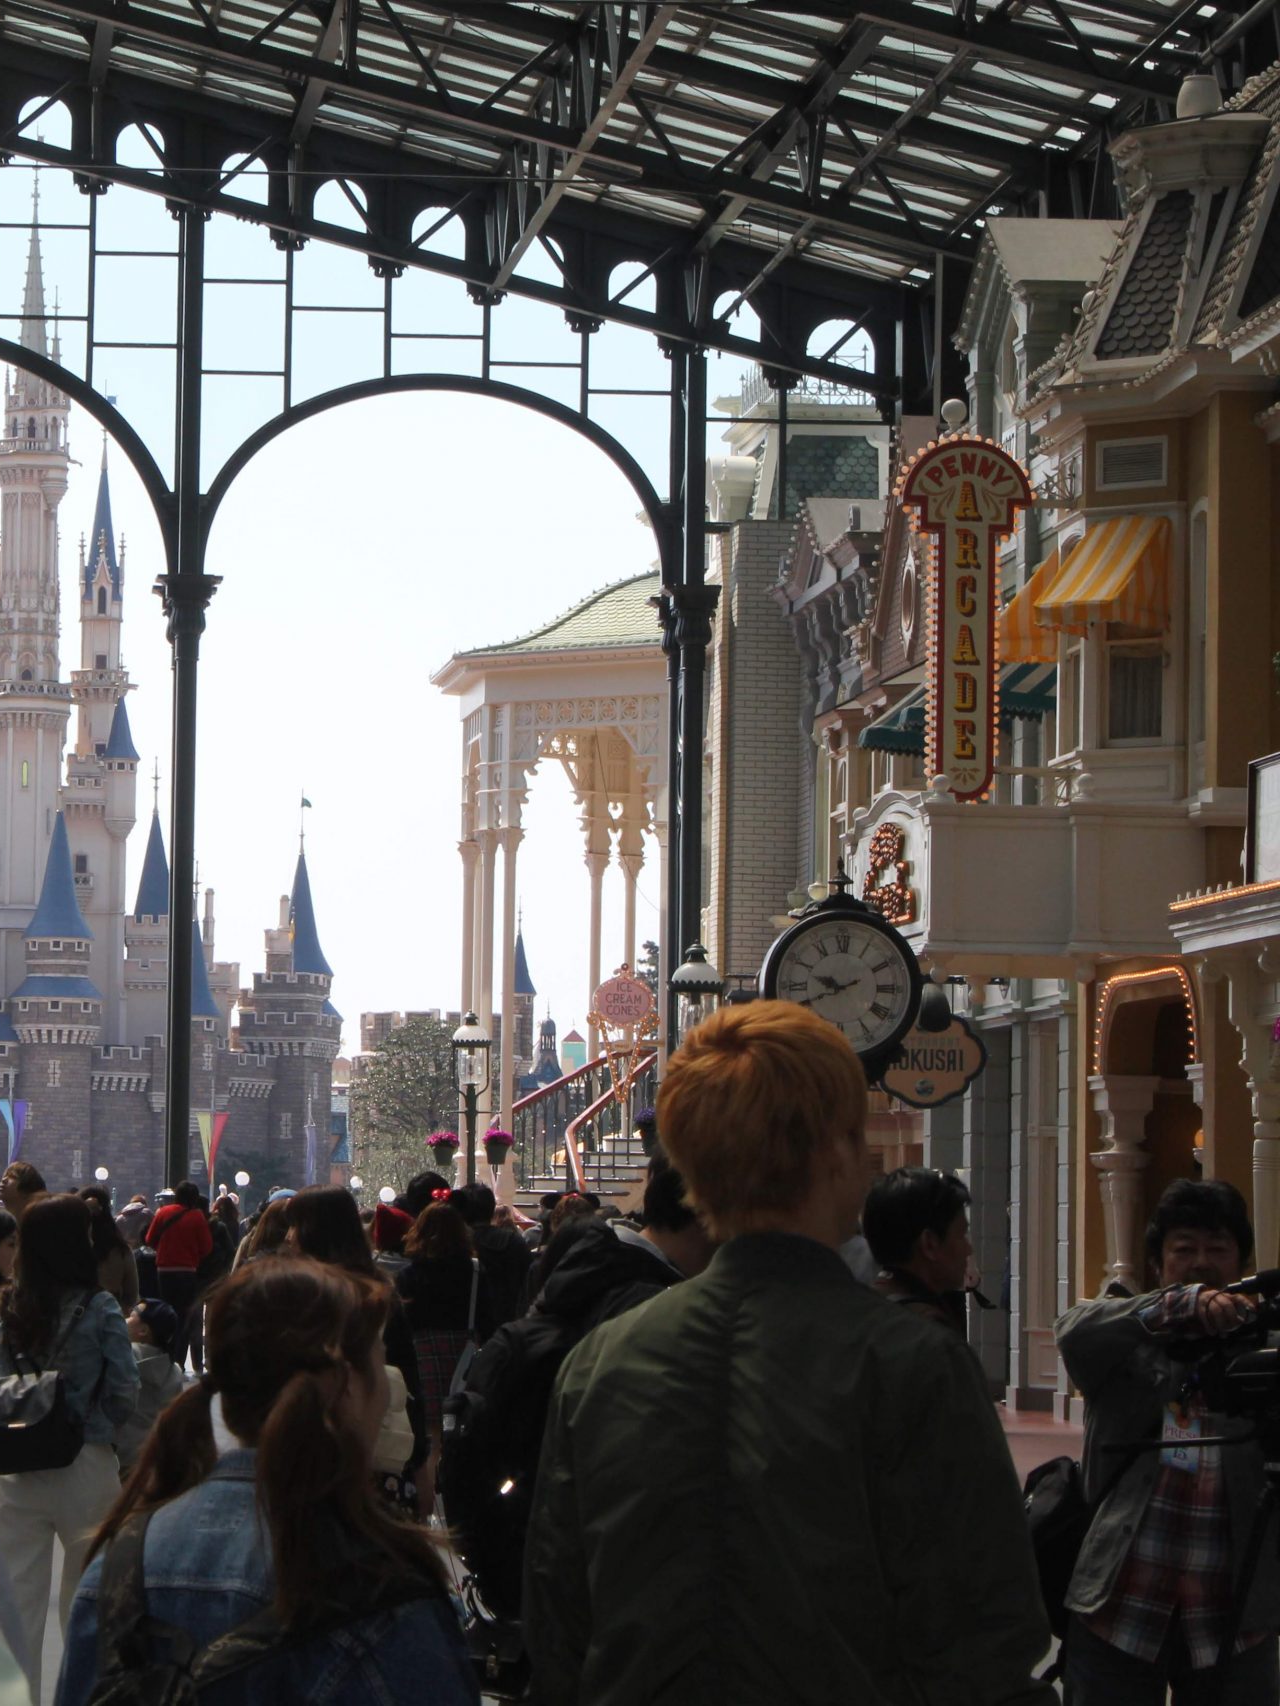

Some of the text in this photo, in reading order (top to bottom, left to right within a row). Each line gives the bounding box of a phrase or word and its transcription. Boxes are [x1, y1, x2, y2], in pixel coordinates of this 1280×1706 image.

[925, 452, 1014, 488] PENNY
[953, 480, 981, 760] ARCADE
[616, 982, 632, 992] ICE
[605, 993, 642, 1004] CREAM
[606, 1005, 640, 1016] CONES
